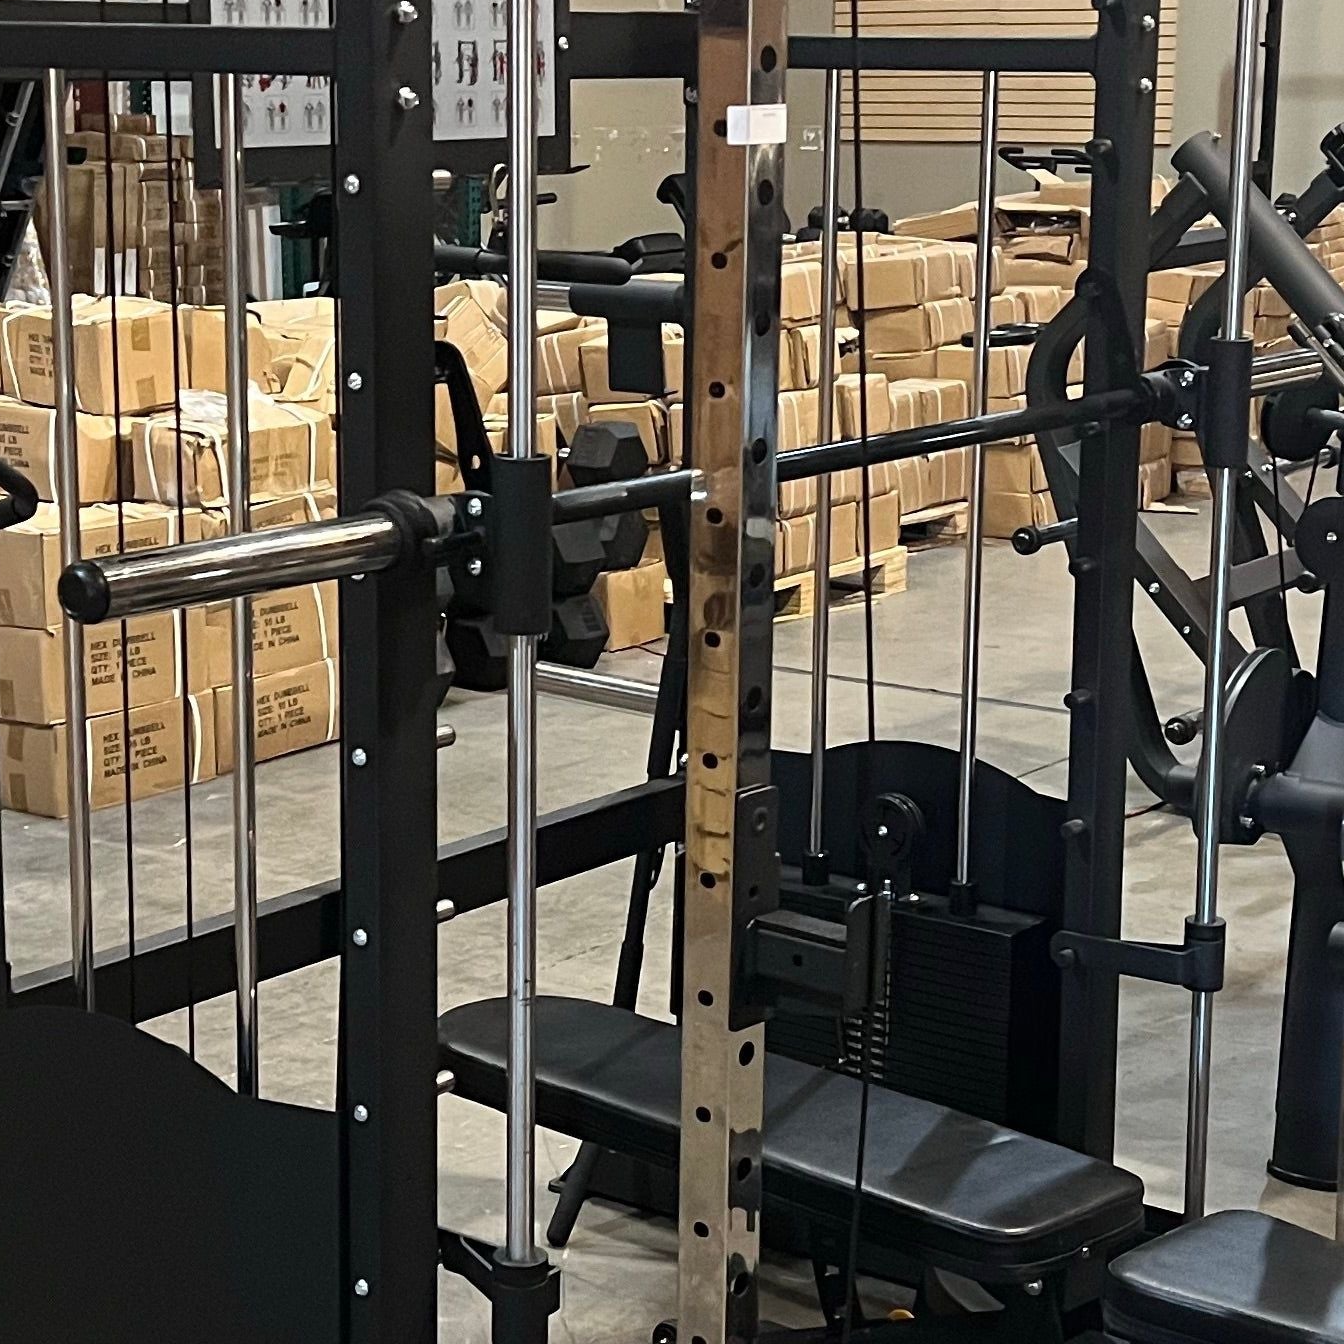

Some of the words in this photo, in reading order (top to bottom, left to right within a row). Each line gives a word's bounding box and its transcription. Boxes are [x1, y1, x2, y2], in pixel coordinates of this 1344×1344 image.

[95, 544, 111, 555] HEX
[117, 536, 160, 552] DMBBELL
[90, 641, 107, 651] HEX
[91, 674, 115, 686] MADE
[132, 667, 156, 678] CHINA
[274, 683, 310, 700] DUMBBELL
[289, 716, 311, 727] CHINA
[103, 733, 119, 743] HEX
[135, 746, 157, 757] PIECE
[143, 755, 167, 768] CHINA
